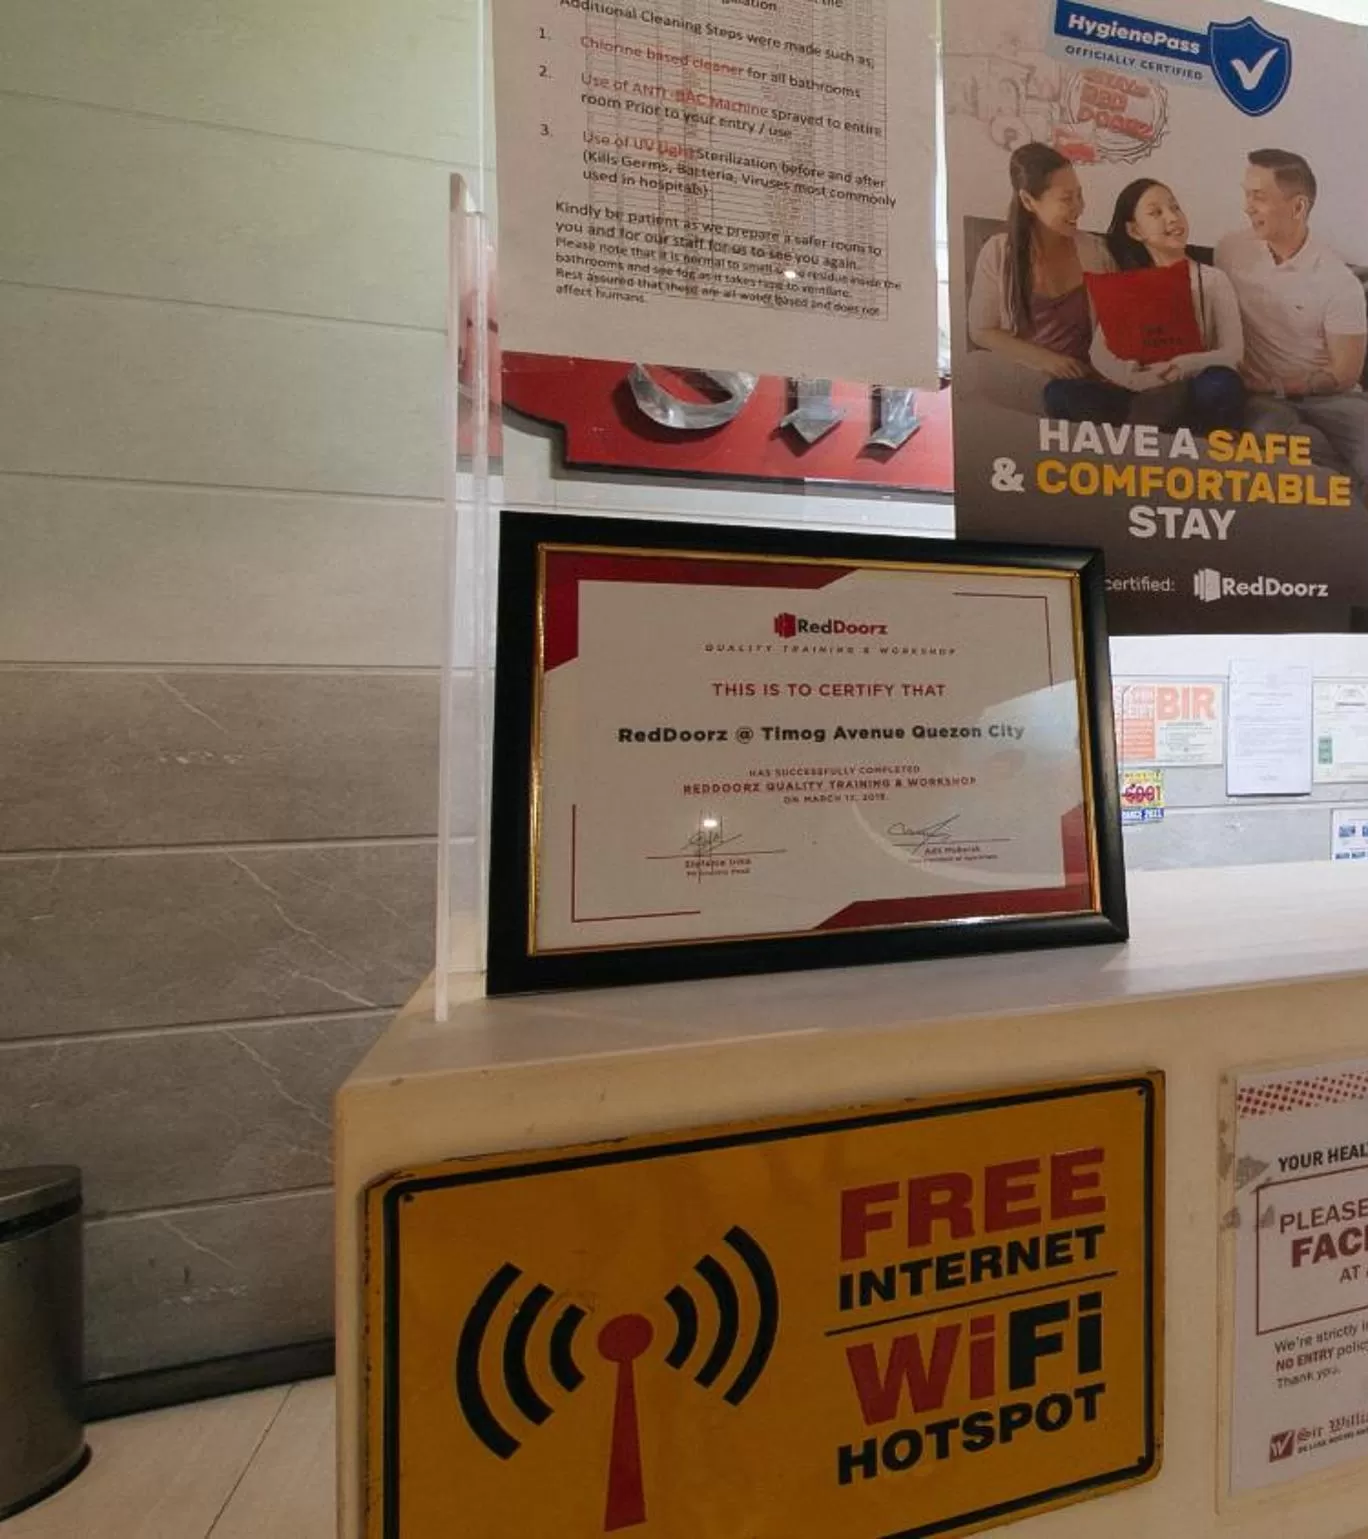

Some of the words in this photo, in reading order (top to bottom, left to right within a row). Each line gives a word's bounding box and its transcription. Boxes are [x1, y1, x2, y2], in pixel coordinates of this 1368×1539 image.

[560, 0, 636, 19] Additional
[641, 10, 701, 35] Cleaning
[706, 22, 743, 41] Steps
[747, 34, 781, 48] were
[784, 40, 820, 57] made
[825, 49, 854, 64] such
[1067, 13, 1200, 54] HygienePass
[581, 36, 641, 58] Chlorine
[646, 47, 689, 66] based
[692, 59, 744, 76] cleaner
[747, 67, 767, 81] for
[771, 71, 785, 84] all
[789, 75, 861, 98] bathrooms
[1065, 45, 1135, 68] OFFICIALLY
[1140, 60, 1204, 81] CERTIFIED
[581, 72, 610, 88] Use
[614, 79, 629, 91] of
[711, 97, 768, 117] Machine
[771, 108, 823, 128] sprayed
[827, 117, 841, 130] to
[844, 121, 882, 137] entire
[581, 93, 621, 110] room
[625, 100, 659, 116] Prior
[664, 106, 680, 119] to
[684, 110, 716, 126] your
[719, 115, 755, 134] entry
[769, 125, 792, 138] use
[583, 131, 610, 145] Use
[615, 136, 631, 149] of
[633, 139, 656, 153] UV
[698, 149, 778, 171] Sterilization
[782, 162, 826, 179] before
[827, 170, 852, 183] and
[855, 176, 885, 188] after
[583, 169, 617, 183] used
[621, 173, 635, 186] in
[583, 149, 617, 167] (Kills
[621, 156, 672, 175] Germs,
[742, 173, 791, 191] Viruses
[794, 183, 826, 197] most
[829, 188, 897, 208] commonly
[556, 200, 600, 219] Kindly
[605, 207, 621, 220] be
[628, 211, 679, 230] patient
[684, 220, 699, 230] as
[701, 221, 724, 235] we
[727, 225, 779, 243] prepare
[794, 234, 826, 249] safer
[830, 240, 865, 253] room
[867, 244, 882, 257] to
[556, 221, 583, 234] you
[588, 223, 616, 239] and
[620, 227, 641, 242] for
[644, 232, 669, 245] our
[673, 234, 704, 248] staff
[708, 238, 729, 252] for
[732, 243, 748, 256] us
[751, 246, 766, 259] to
[769, 250, 793, 263] see
[795, 253, 820, 266] you
[1039, 418, 1159, 457] HAVE
[1169, 428, 1199, 459] A
[1208, 429, 1311, 465] SAFE
[991, 457, 1025, 492] &
[1035, 460, 1351, 507] COMFORTABLE
[1128, 505, 1236, 540] STAY
[1223, 576, 1328, 597] RedDoorz
[797, 618, 888, 636] RedDoorz
[705, 643, 772, 653] QUALITY
[783, 644, 855, 655] TRAINING
[880, 647, 956, 656] WORKSHOP
[712, 683, 756, 697] THIS
[763, 684, 780, 697] IS
[787, 683, 812, 697] TO
[818, 683, 895, 698] CERTIFY
[901, 683, 946, 698] THAT
[1157, 687, 1217, 720] BIR
[618, 726, 728, 743] RedDoorz
[736, 727, 754, 744] @
[762, 726, 827, 743] Timog
[833, 725, 905, 741] Avenue
[911, 724, 982, 740] Quezon
[988, 723, 1026, 741] City
[683, 783, 760, 795] REDDOORZ
[765, 781, 824, 792] QUALITY
[829, 779, 891, 790] TRAINING
[907, 776, 977, 788] WORKSHOP
[775, 766, 856, 777] SUCCESSFULLY
[859, 765, 921, 775] COMPLETED
[1278, 1149, 1325, 1172] YOUR
[840, 1147, 1107, 1262] FREE
[839, 1224, 1105, 1311] INTERNET
[1339, 1263, 1361, 1284] AT
[1274, 1330, 1313, 1355] We're
[1315, 1318, 1359, 1347] strictly
[846, 1291, 1103, 1427] WiFi
[1275, 1355, 1294, 1373] NO
[1297, 1346, 1335, 1368] ENTRY
[1276, 1369, 1314, 1390] Thank
[837, 1383, 1107, 1487] HOTSPOT
[1296, 1425, 1324, 1442] Sir
